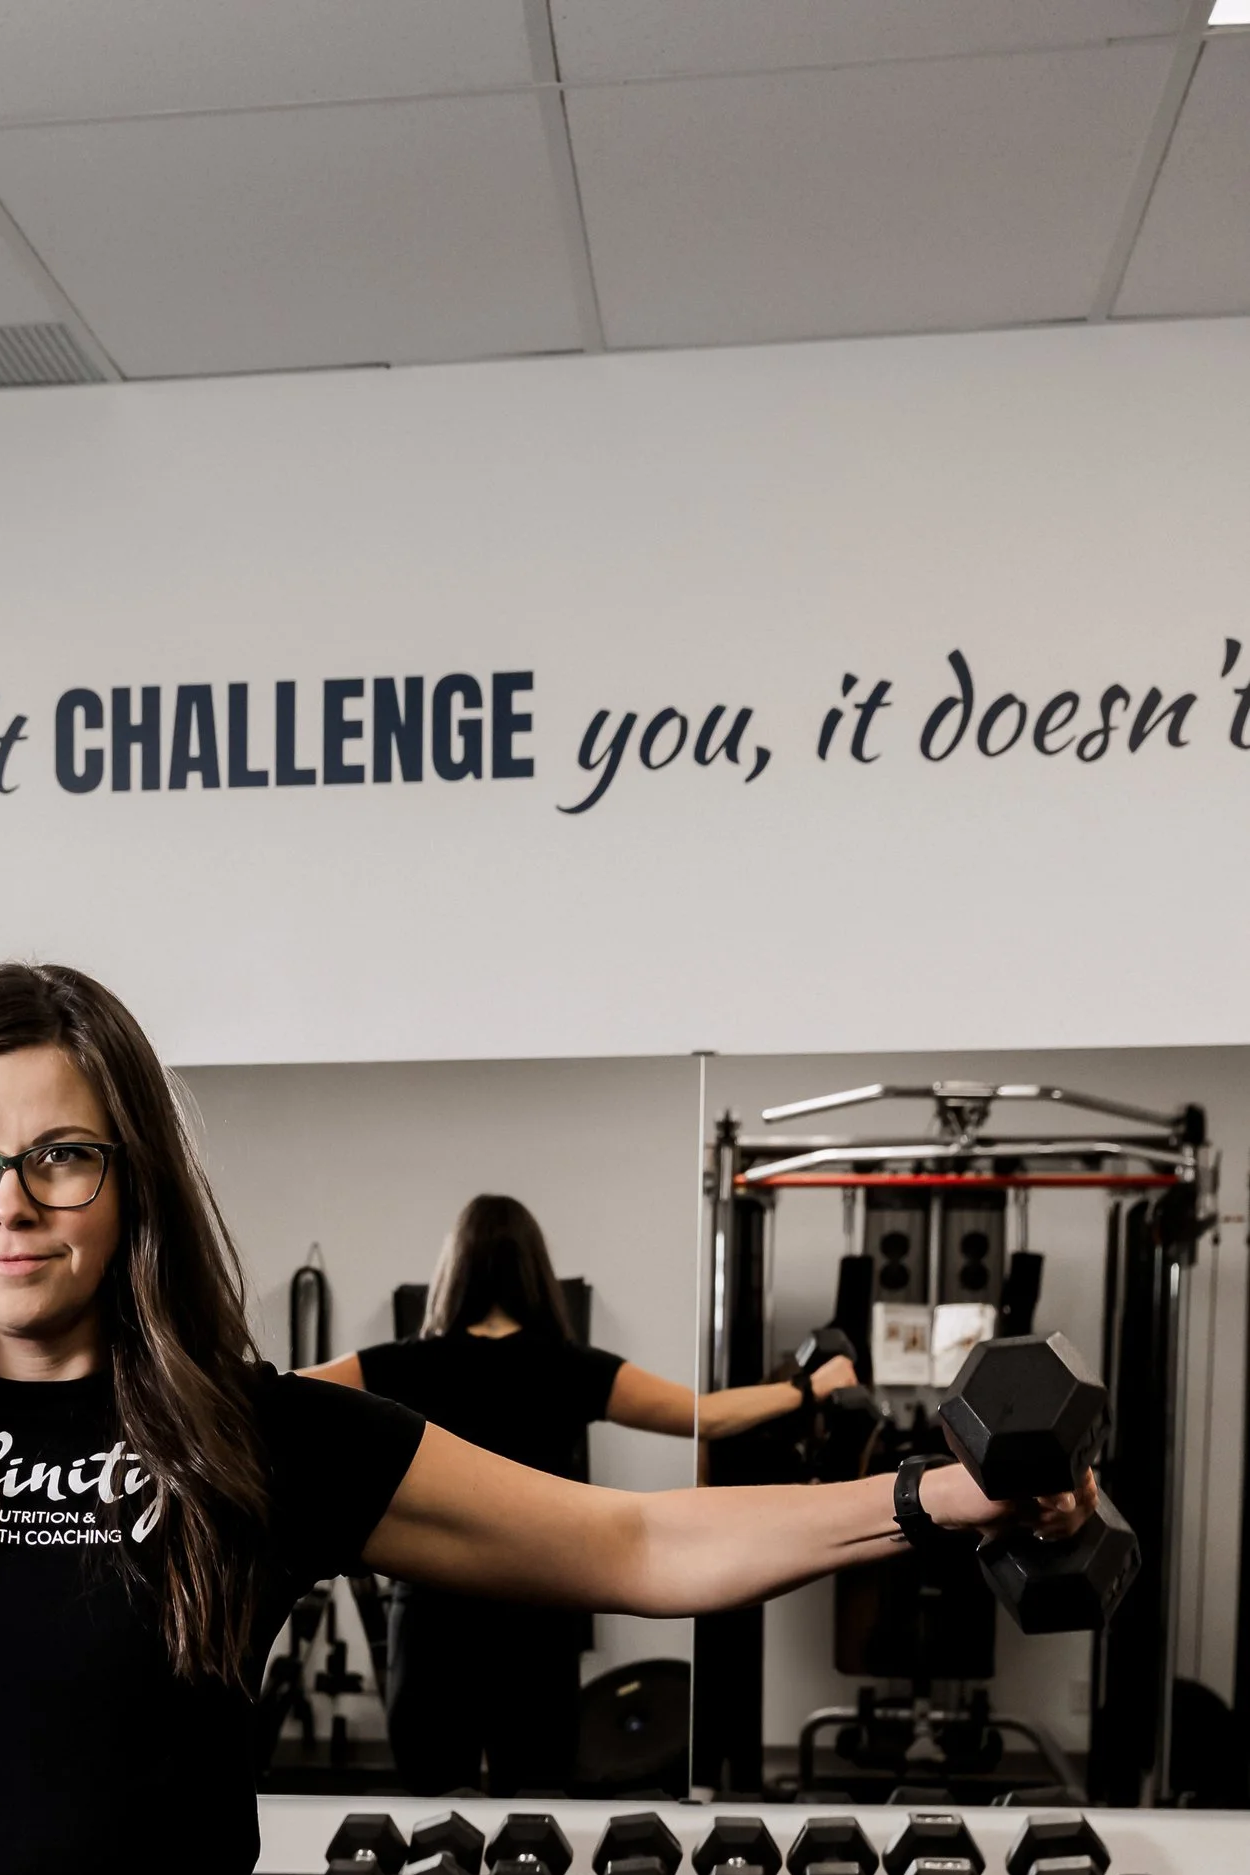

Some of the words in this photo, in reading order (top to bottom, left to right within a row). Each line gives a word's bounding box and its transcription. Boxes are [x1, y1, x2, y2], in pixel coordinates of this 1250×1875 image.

[55, 670, 535, 794] CHALLENGE
[555, 704, 772, 815] you,
[817, 672, 893, 764] it
[82, 1511, 96, 1524] &
[24, 1529, 122, 1545] COACHING
